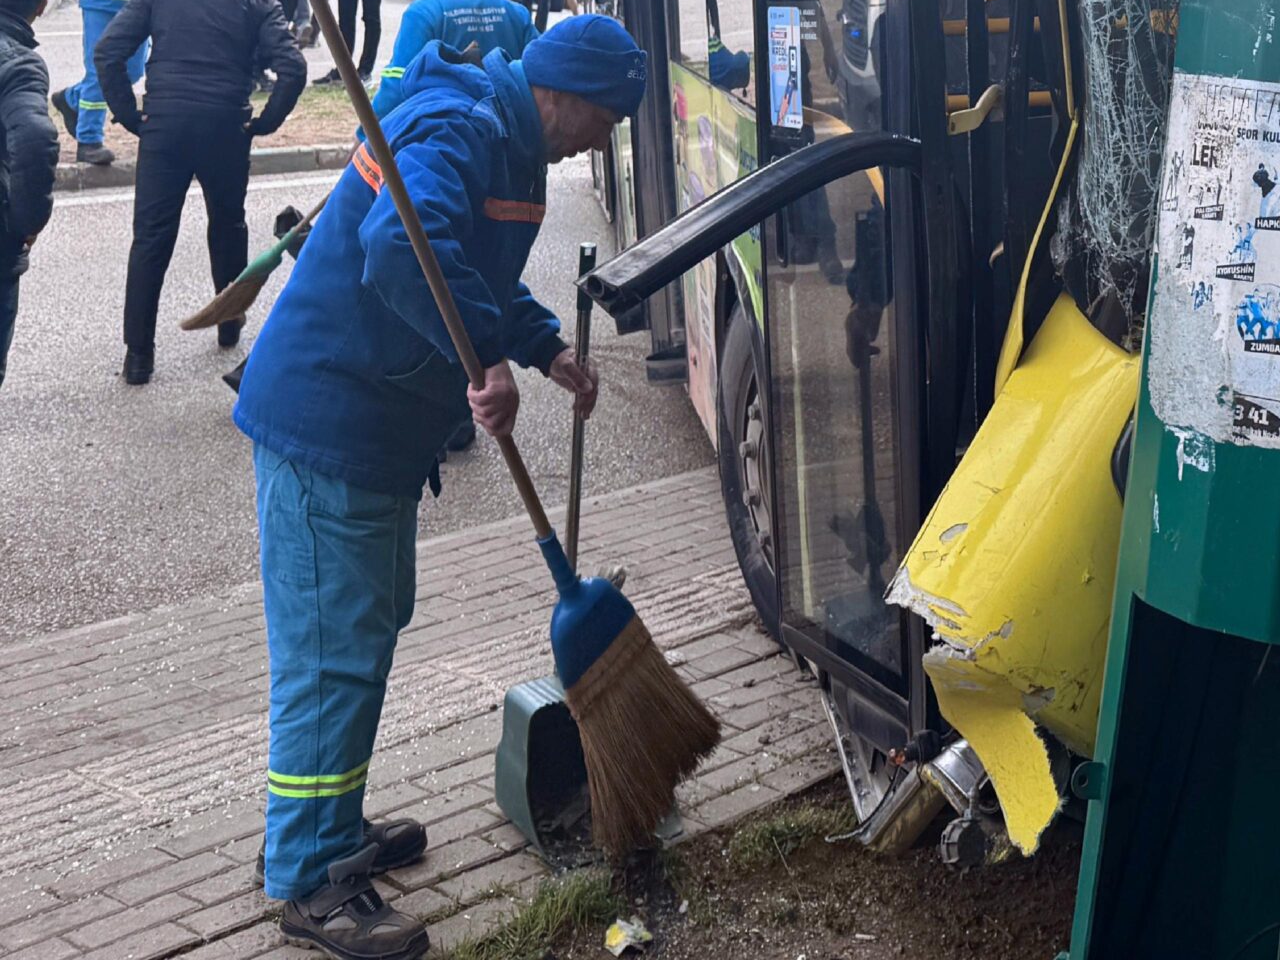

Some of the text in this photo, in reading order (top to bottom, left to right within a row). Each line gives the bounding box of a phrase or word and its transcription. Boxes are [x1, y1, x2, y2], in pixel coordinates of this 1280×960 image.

[1236, 127, 1259, 141] SPOR
[1216, 265, 1254, 276] KYOKUSHİN
[1250, 342, 1280, 353] ZUMBA
[1248, 407, 1270, 426] 41
